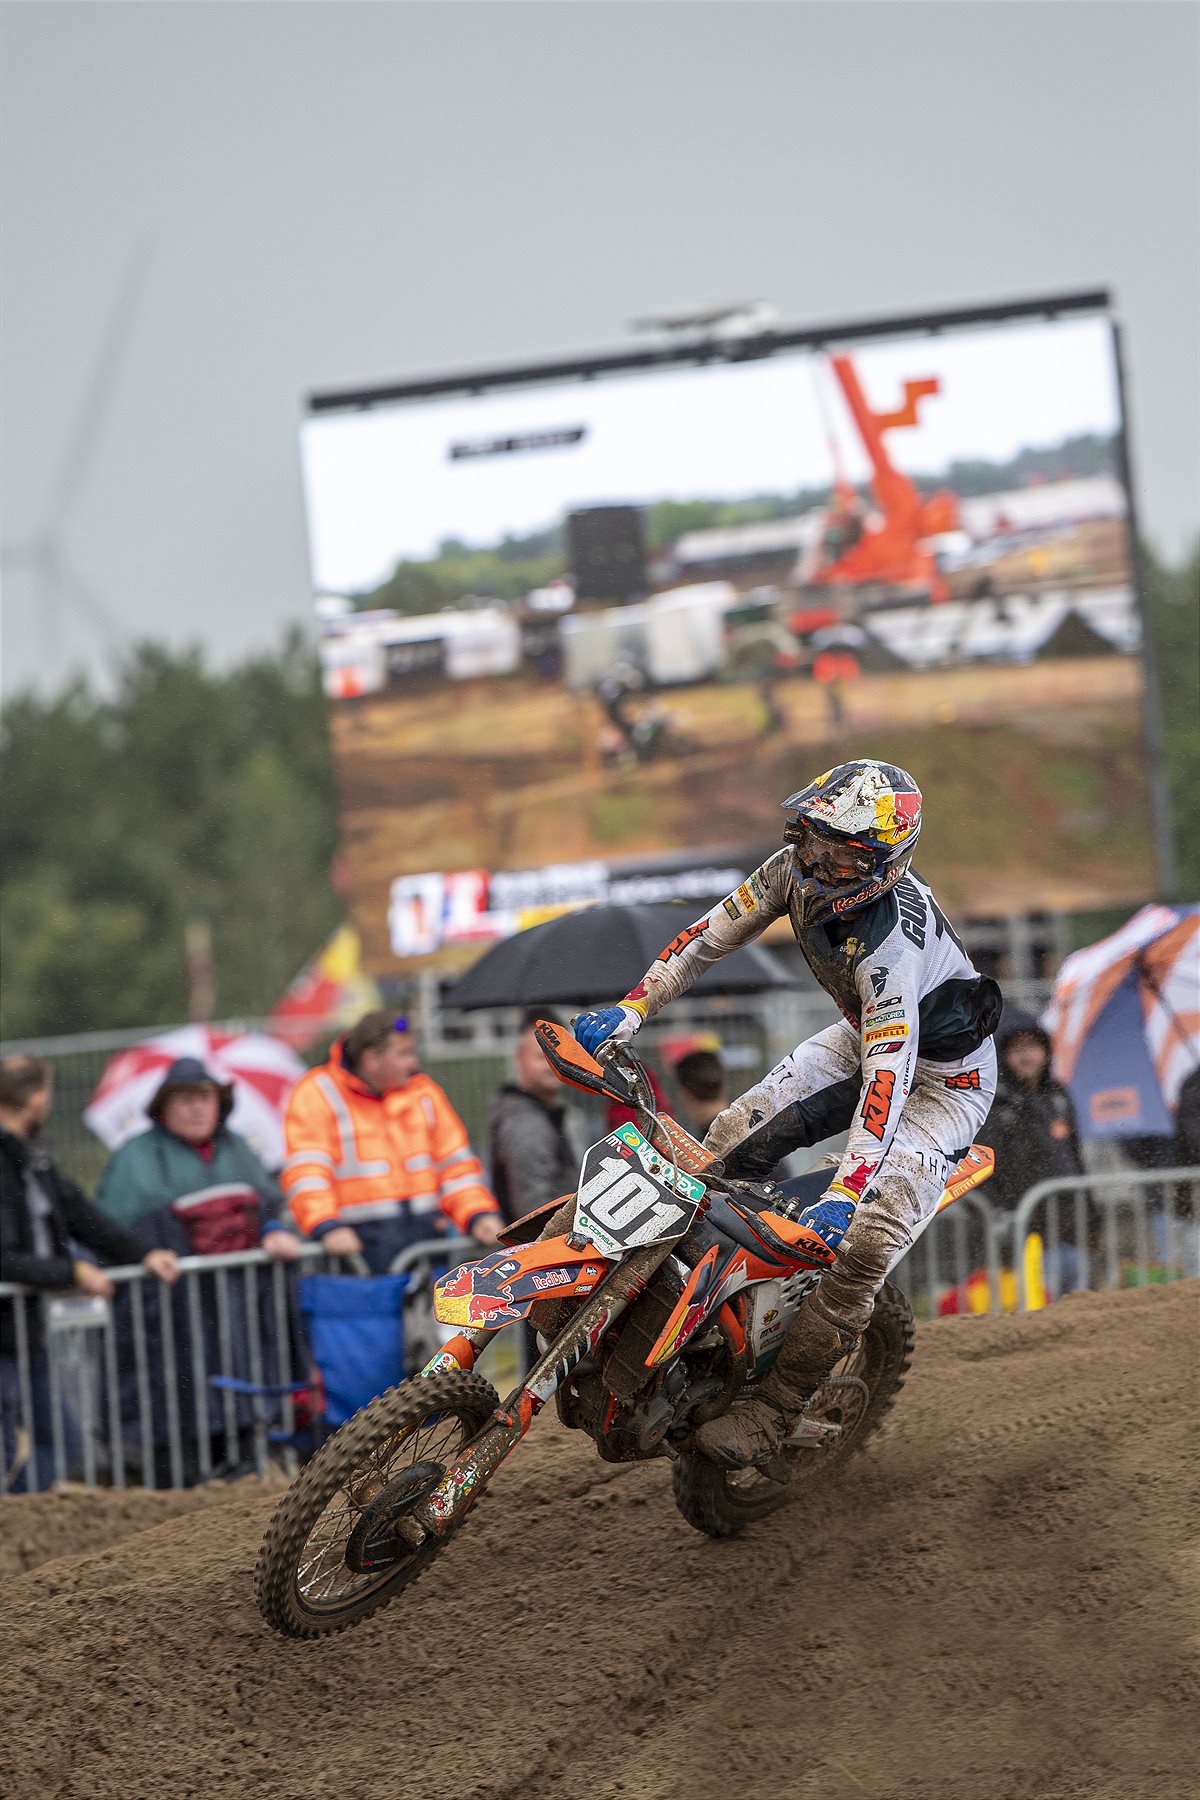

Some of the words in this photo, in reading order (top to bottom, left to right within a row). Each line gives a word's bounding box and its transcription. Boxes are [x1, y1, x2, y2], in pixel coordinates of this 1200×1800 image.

[875, 1011, 904, 1023] MOTOREX
[539, 1022, 561, 1048] KTM
[865, 1026, 906, 1043] PIRELLI
[902, 1051, 912, 1088] ATHENA
[860, 1069, 896, 1143] KTM
[578, 1156, 686, 1248] 101
[793, 1238, 832, 1258] KTM
